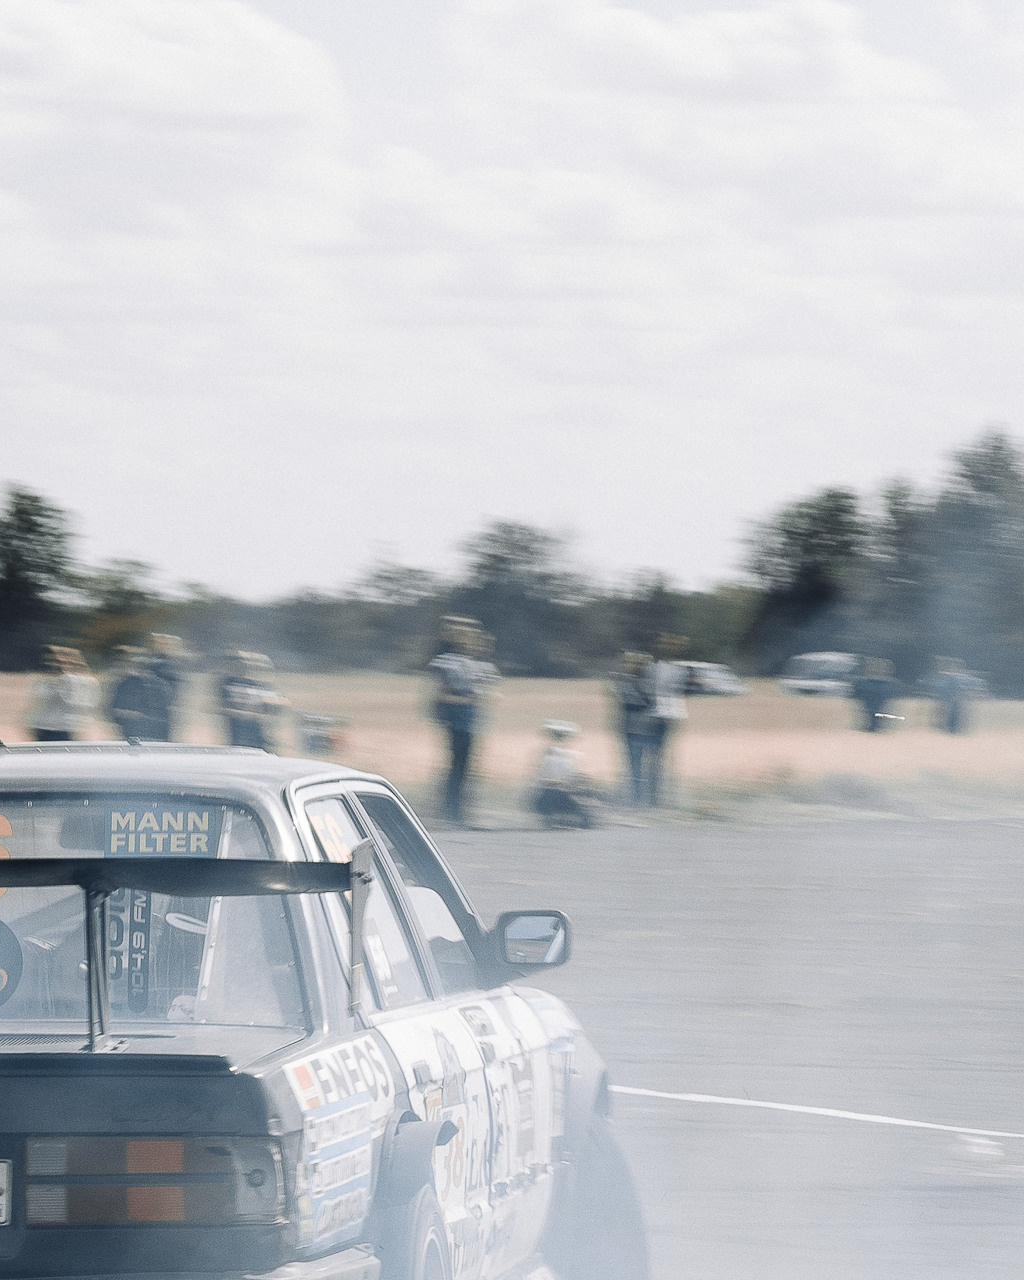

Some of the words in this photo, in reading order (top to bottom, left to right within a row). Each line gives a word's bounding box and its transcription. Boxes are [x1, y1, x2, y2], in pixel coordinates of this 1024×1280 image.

[109, 810, 210, 832] MANN
[109, 833, 209, 854] FILTER
[310, 1040, 390, 1104] ENEOS
